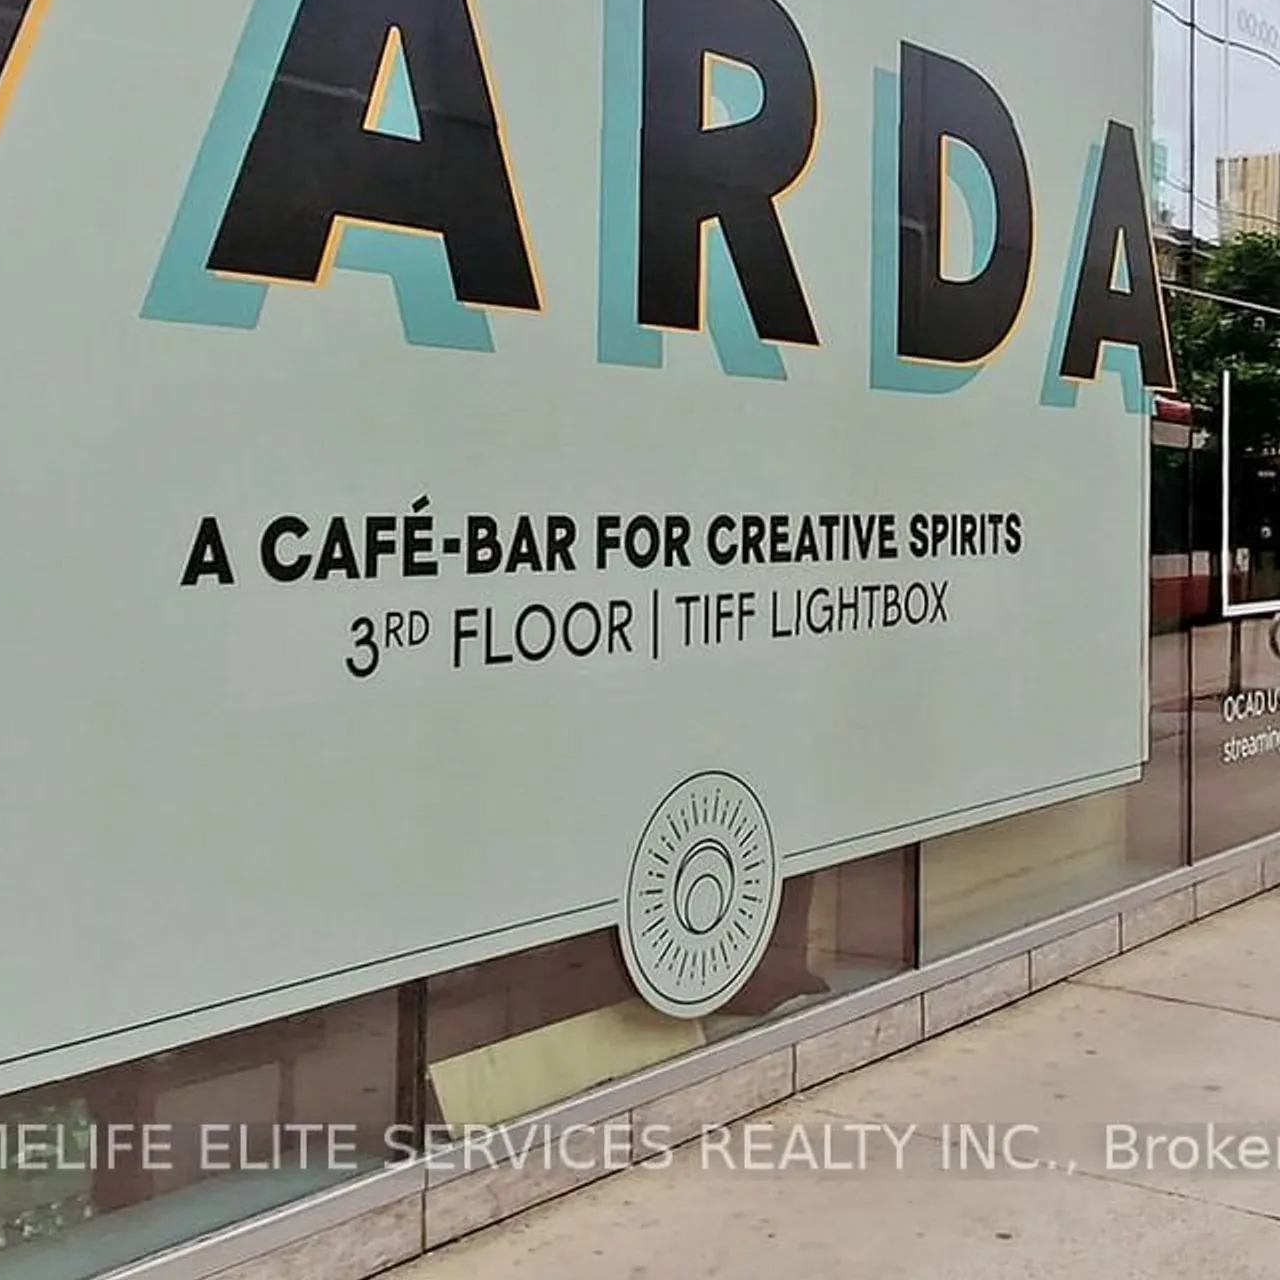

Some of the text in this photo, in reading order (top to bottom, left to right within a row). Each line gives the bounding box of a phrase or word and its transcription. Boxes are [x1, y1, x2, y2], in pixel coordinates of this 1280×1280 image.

[178, 494, 1022, 587] A CAFÉ-BAR FOR CREATIVE SPIRITS
[345, 610, 430, 678] 3RD
[453, 599, 633, 669] FLOOR
[674, 591, 756, 647] TIFF
[771, 580, 948, 639] LIGHTBOX
[1224, 691, 1265, 722] OCAD
